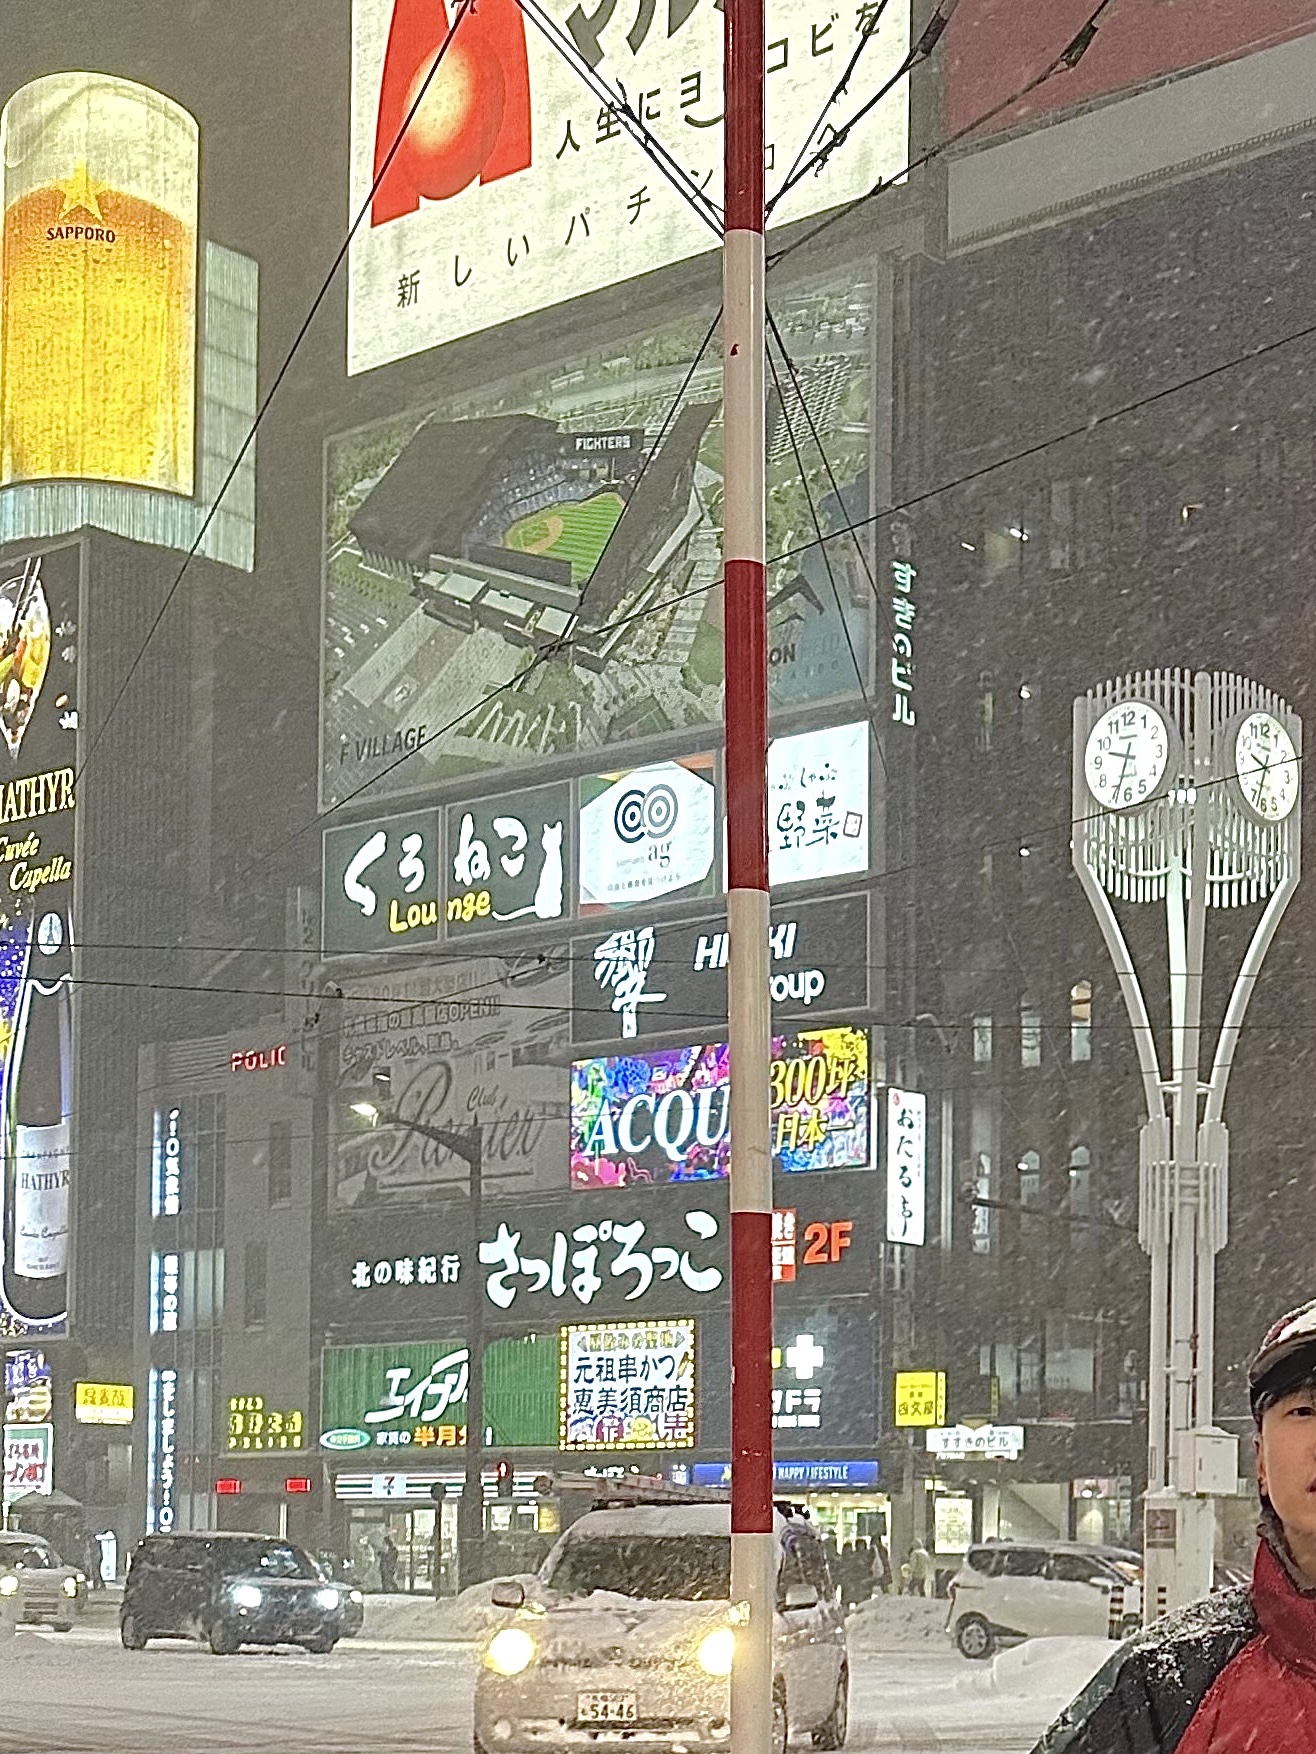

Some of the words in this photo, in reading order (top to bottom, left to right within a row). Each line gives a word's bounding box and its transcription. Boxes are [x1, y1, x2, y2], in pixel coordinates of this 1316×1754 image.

[556, 2, 880, 160] 人生にヨコビを
[46, 226, 116, 243] SAPPORO
[575, 434, 631, 450] FIGHTERS
[1108, 719, 1120, 735] 11
[1121, 711, 1136, 726] 12
[1140, 715, 1148, 729] 1
[1150, 726, 1159, 739] 2
[340, 745, 354, 764] F
[356, 724, 428, 761] VILLAGE
[1097, 736, 1112, 751] 10
[1155, 744, 1163, 758] 3
[1094, 756, 1103, 770] 9
[1149, 764, 1157, 777] 4
[1098, 774, 1107, 788] 8
[1138, 780, 1147, 794] 5
[1123, 787, 1133, 801] 6
[776, 797, 840, 850] 野菜
[344, 812, 530, 916] くろねこ
[9, 856, 72, 893] Capella
[389, 888, 492, 933] Lounge
[694, 923, 797, 971] HIKI
[769, 968, 825, 1006] oup
[583, 1085, 731, 1163] ACQU
[775, 1112, 856, 1154] 日本一
[803, 1221, 853, 1264] 2F
[480, 1210, 723, 1308] さっぽろっこ
[352, 1254, 461, 1288] 北の味紀行
[574, 1354, 676, 1384] 元祖串かつ
[573, 1384, 688, 1415] 恵美須商店
[942, 1436, 1009, 1449] すすきのビル
[778, 1466, 804, 1480] HAPPY
[806, 1464, 849, 1480] LIFESTYLE
[590, 1703, 634, 1719] 54-46
